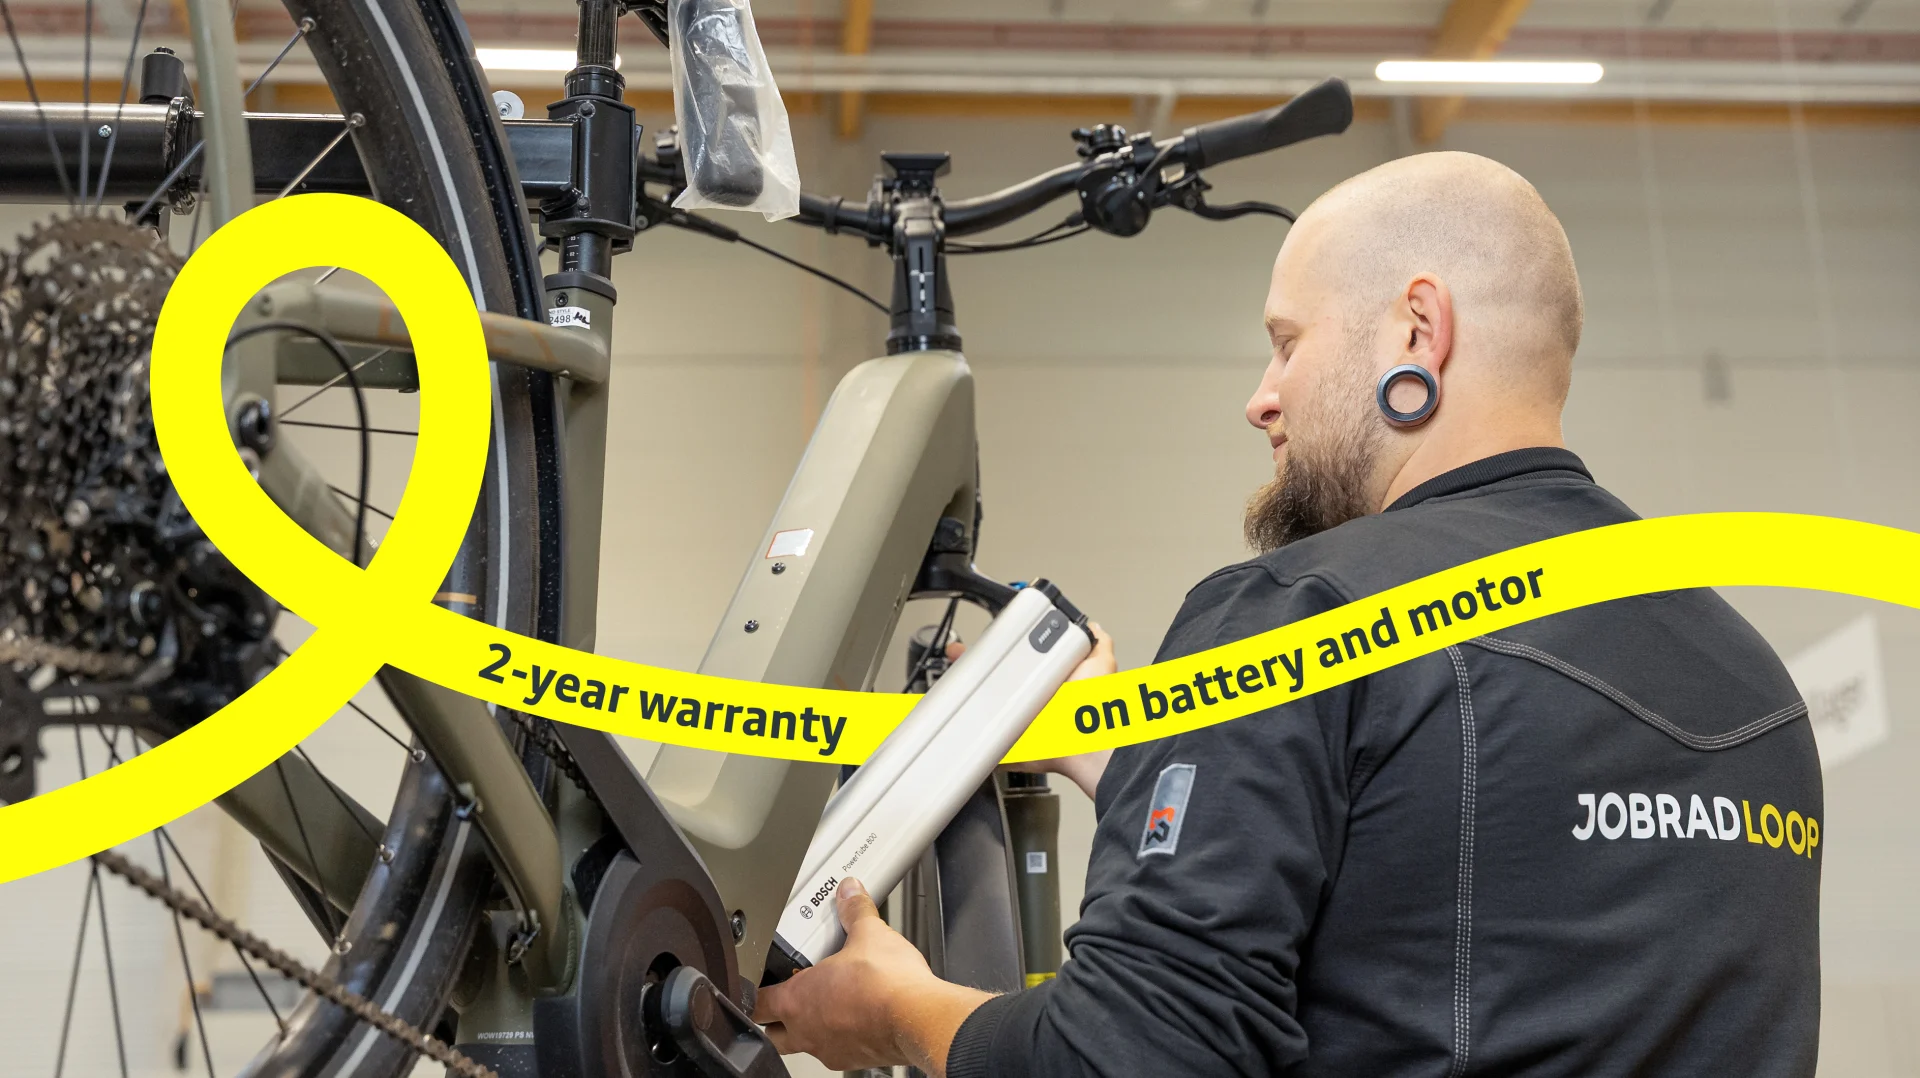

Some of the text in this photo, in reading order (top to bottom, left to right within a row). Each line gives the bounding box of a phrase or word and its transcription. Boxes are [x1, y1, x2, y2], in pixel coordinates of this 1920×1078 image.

[842, 832, 877, 872] PowerTube 800
[810, 876, 838, 907] BOSCH
